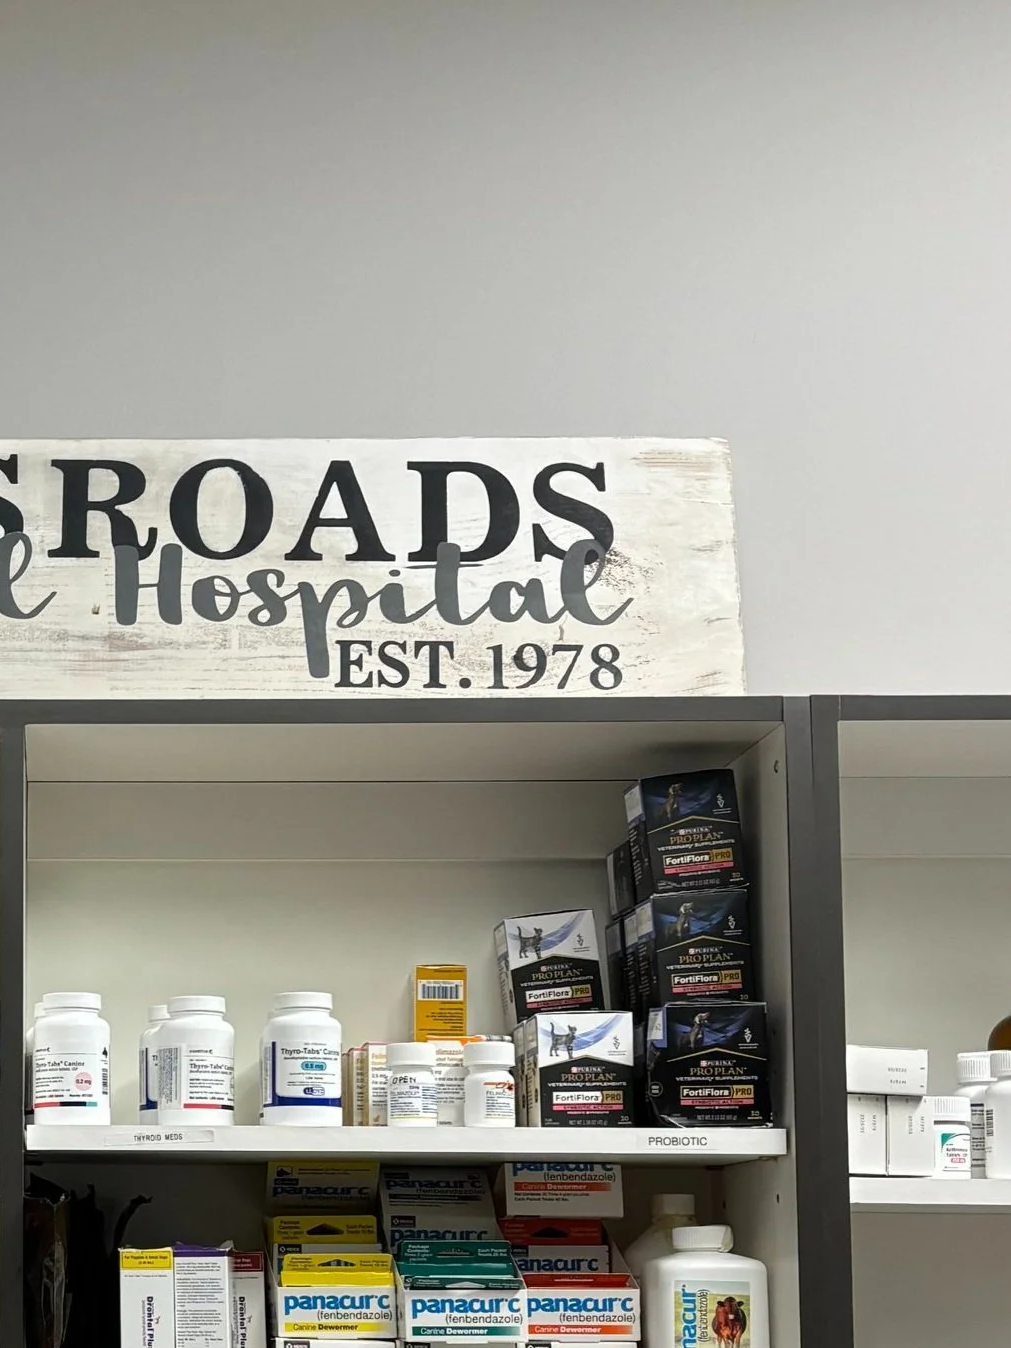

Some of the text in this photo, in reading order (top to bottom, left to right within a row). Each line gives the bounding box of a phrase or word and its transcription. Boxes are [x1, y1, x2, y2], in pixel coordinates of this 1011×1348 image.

[114, 539, 634, 678] Hospital
[334, 641, 623, 689] EST. 1978
[693, 832, 721, 842] PLAN
[666, 851, 730, 865] FortiFlora PRO
[679, 953, 730, 964] PRO PLAN
[532, 970, 579, 980] PRO PLAN
[674, 972, 739, 984] FortiFlora PRO
[528, 991, 569, 1000] FortiFlora
[281, 1048, 319, 1057] Thyro-Tabs
[64, 1060, 85, 1068] Canine
[561, 1073, 613, 1081] PRO PLAN
[690, 1068, 714, 1076] PRO
[735, 1088, 752, 1096] PRO
[555, 1093, 621, 1102] FortiFlora PRO
[134, 1133, 183, 1142] THYROID MEDS
[648, 1137, 707, 1147] PROBIOTIC
[543, 1172, 616, 1182] (fenbendazole)
[147, 1296, 155, 1330] Drontal
[317, 1310, 392, 1321] (fenbendazole)
[445, 1313, 523, 1325] (fenbendazole)
[559, 1313, 636, 1324] (fenbendazole)
[293, 1323, 358, 1331] Canine Dewormer
[421, 1327, 488, 1335] Canine Dewormer
[560, 1326, 601, 1334] Dewormer
